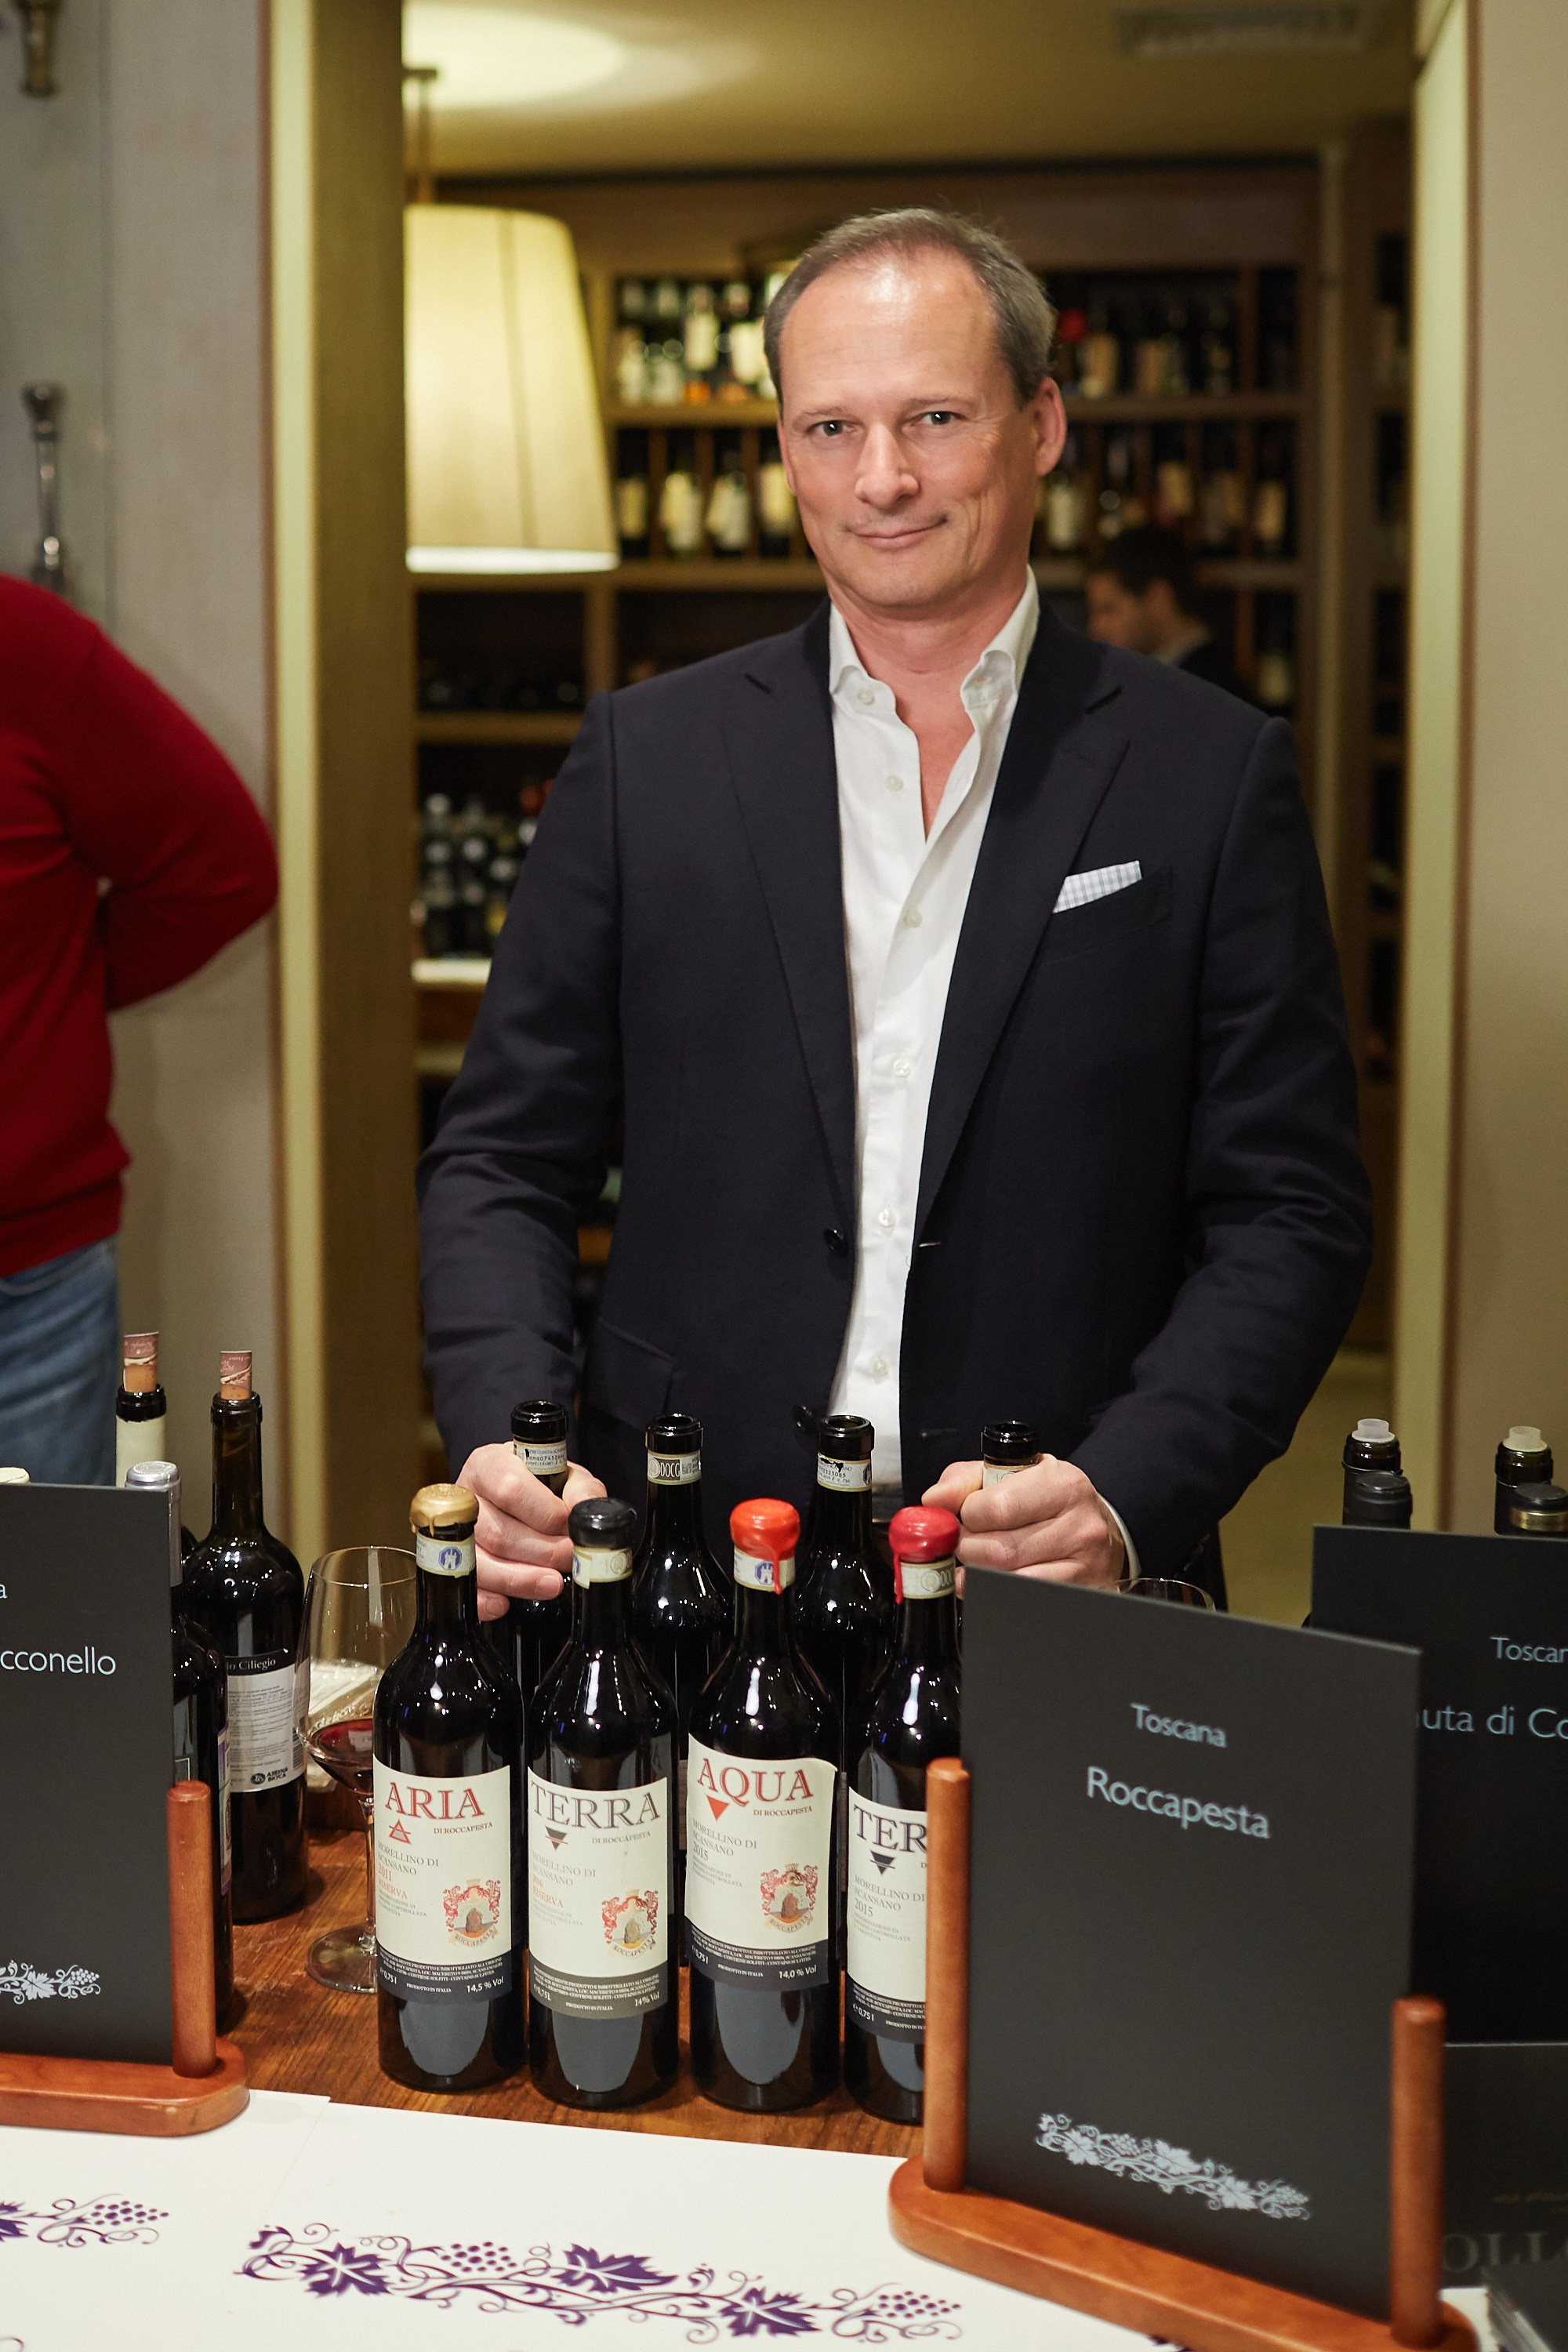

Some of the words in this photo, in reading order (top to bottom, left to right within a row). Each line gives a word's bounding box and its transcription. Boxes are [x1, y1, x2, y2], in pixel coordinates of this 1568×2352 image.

[0, 1646, 116, 1675] cconello
[238, 1657, 276, 1671] Ciliegio
[1130, 1702, 1227, 1749] Toscana
[1417, 1704, 1475, 1732] uta
[1486, 1705, 1515, 1735] di
[698, 1758, 814, 1807] AQUA
[384, 1781, 485, 1820] ARIA
[531, 1780, 660, 1829] TERRA
[764, 1806, 812, 1816] ROCCAPESTA
[1086, 1765, 1271, 1839] Roccapesta
[445, 1822, 493, 1834] ROCCAPESTA
[603, 1831, 651, 1844] ROCCAPESTA
[693, 1818, 742, 1846] MORELLINO
[745, 1840, 757, 1849] DI
[378, 1840, 424, 1866] MORELLINO
[693, 1831, 734, 1857] SCANSANO
[693, 1841, 709, 1861] 2015
[378, 1852, 417, 1875] SCANSANO
[584, 1868, 596, 1877] DI
[855, 1875, 909, 1902] MORELLINO
[913, 1893, 925, 1902] DI
[855, 1887, 902, 1911] SCANSANO
[855, 1897, 873, 1917] 2015
[779, 1969, 795, 1979] 14,0
[805, 1965, 816, 1975] Vol
[467, 1983, 483, 1993] 14,5
[492, 1976, 503, 1987] Vol
[858, 2009, 870, 2020] 0,75
